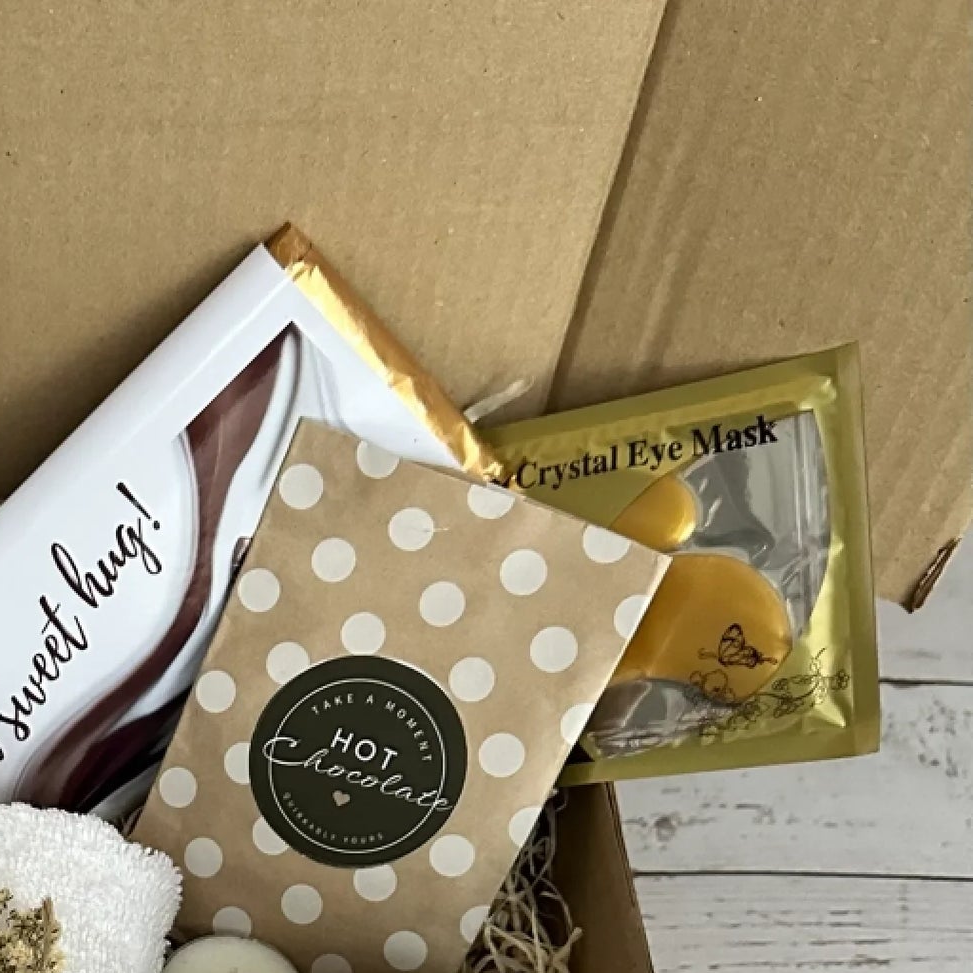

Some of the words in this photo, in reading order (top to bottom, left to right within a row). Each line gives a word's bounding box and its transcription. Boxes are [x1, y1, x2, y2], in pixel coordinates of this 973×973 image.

[515, 444, 619, 491] Crystal
[627, 438, 683, 471] Eye
[690, 414, 778, 457] Mask
[50, 481, 163, 609] hug!
[311, 692, 355, 716] TAKE
[366, 693, 374, 704] A
[384, 700, 433, 762] MOMENT
[329, 726, 399, 771] HOT
[261, 735, 455, 811] Chocolate
